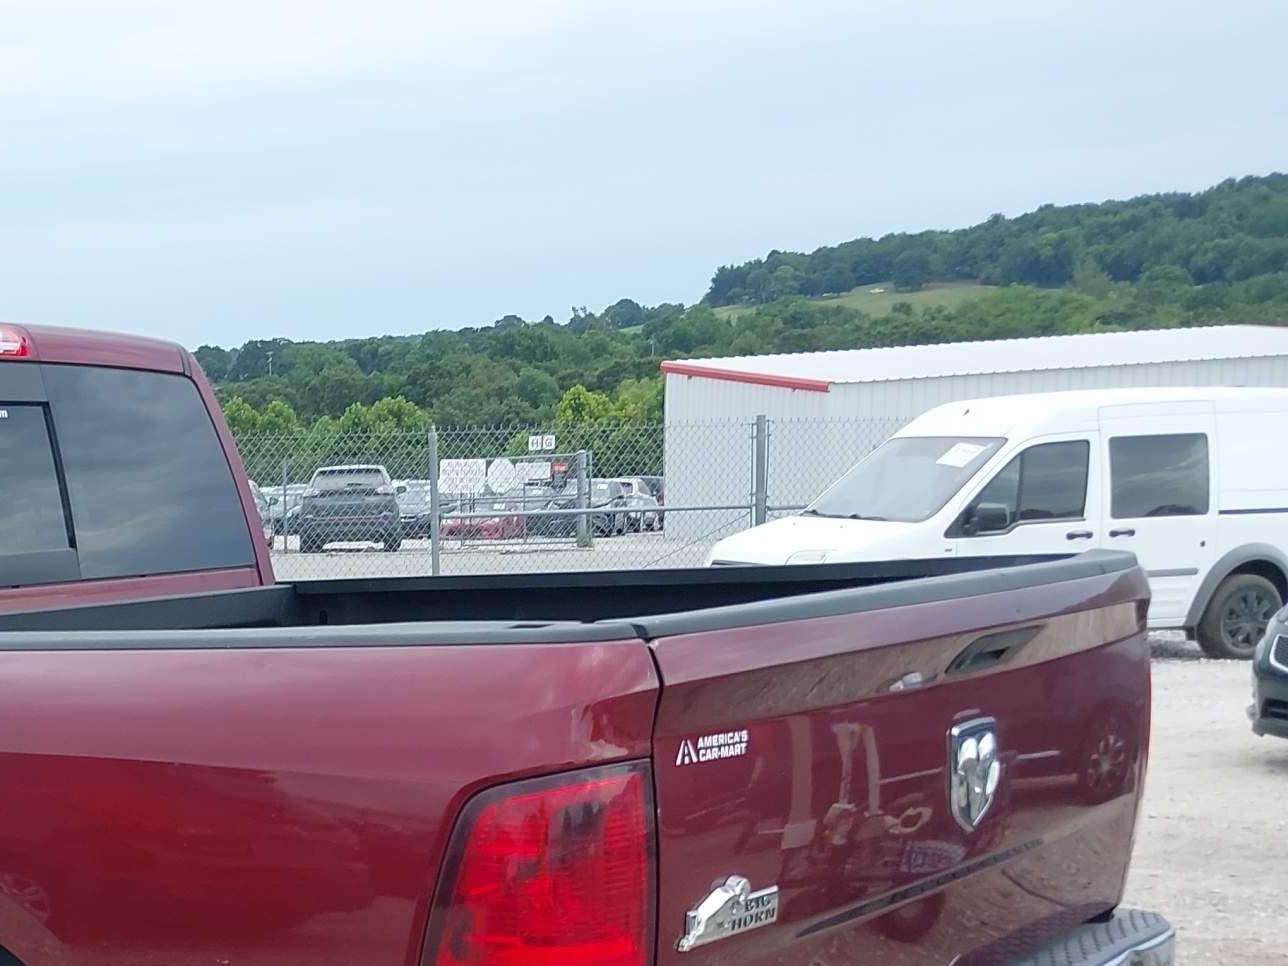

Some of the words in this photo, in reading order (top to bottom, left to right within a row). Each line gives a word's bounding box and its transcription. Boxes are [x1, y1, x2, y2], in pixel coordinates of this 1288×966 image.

[697, 730, 748, 749] AMERICA'S
[699, 743, 747, 762] CAR-MART
[744, 895, 771, 913] BIG
[731, 908, 776, 931] HORN
